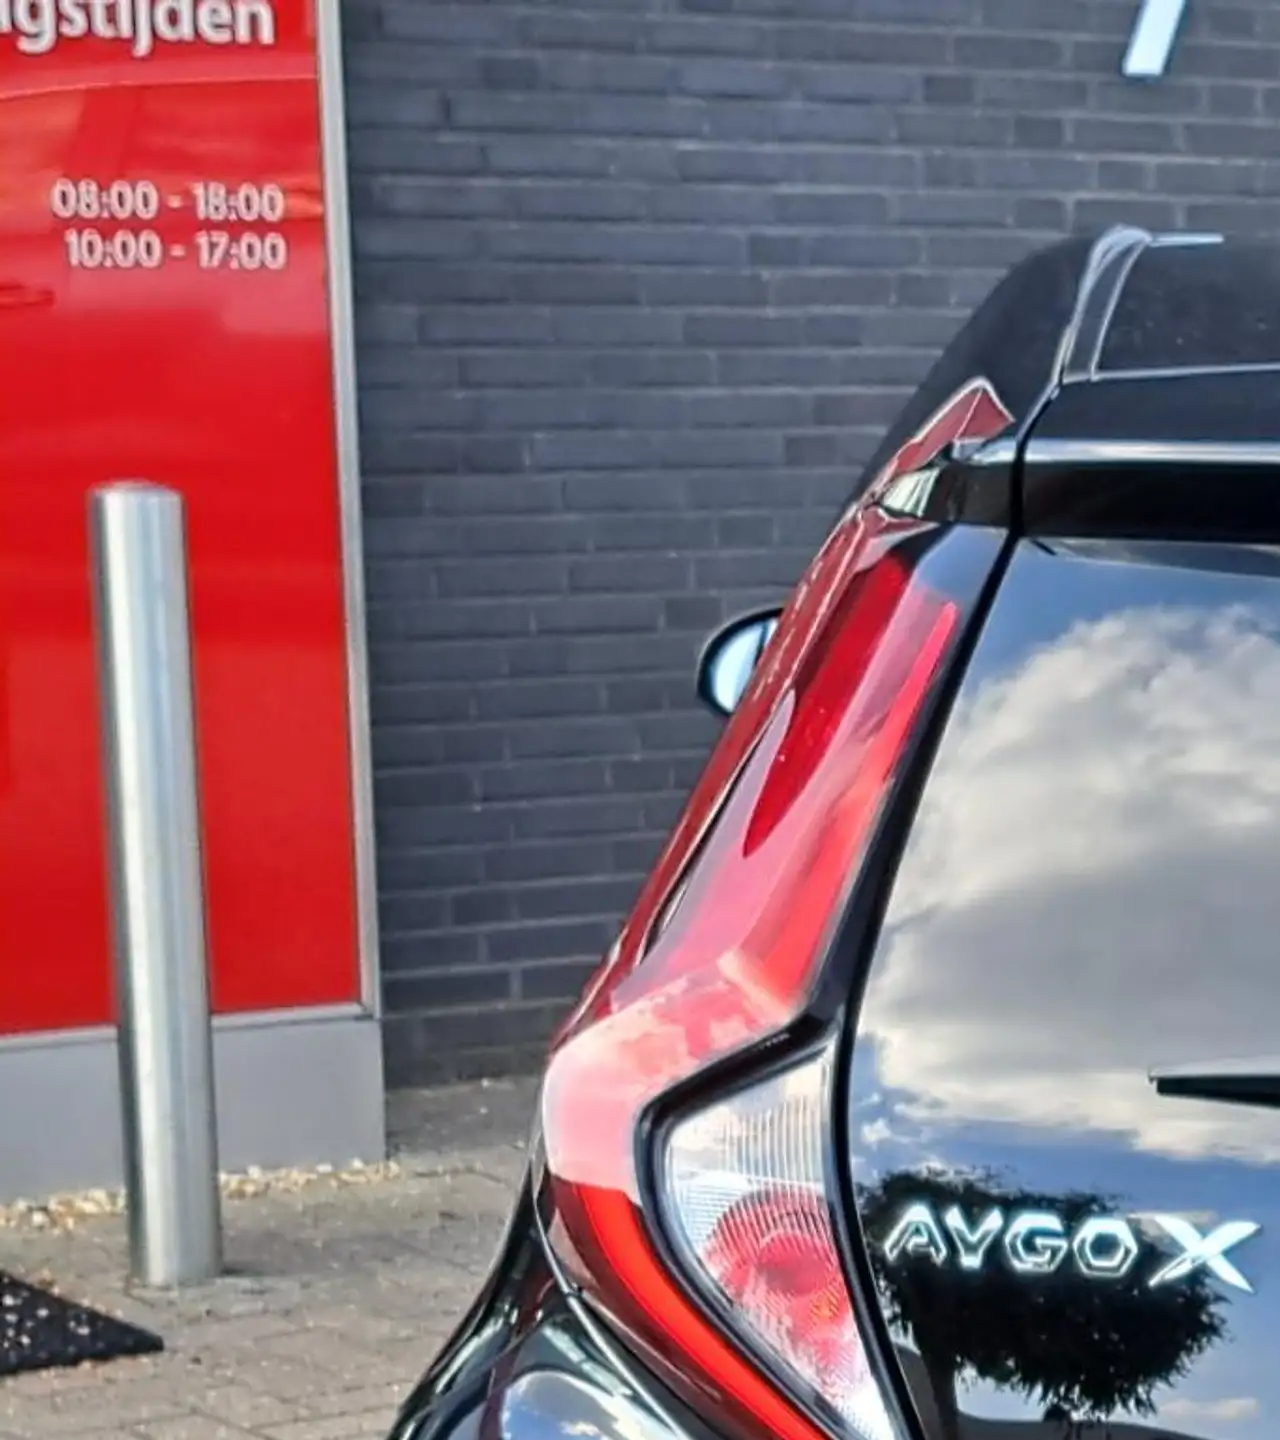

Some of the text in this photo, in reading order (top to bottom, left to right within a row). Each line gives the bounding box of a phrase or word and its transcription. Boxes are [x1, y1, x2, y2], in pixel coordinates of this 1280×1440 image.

[51, 178, 159, 220] 08:00
[191, 181, 285, 222] 18:00
[64, 228, 162, 268] 10:00
[193, 230, 287, 270] 17:00
